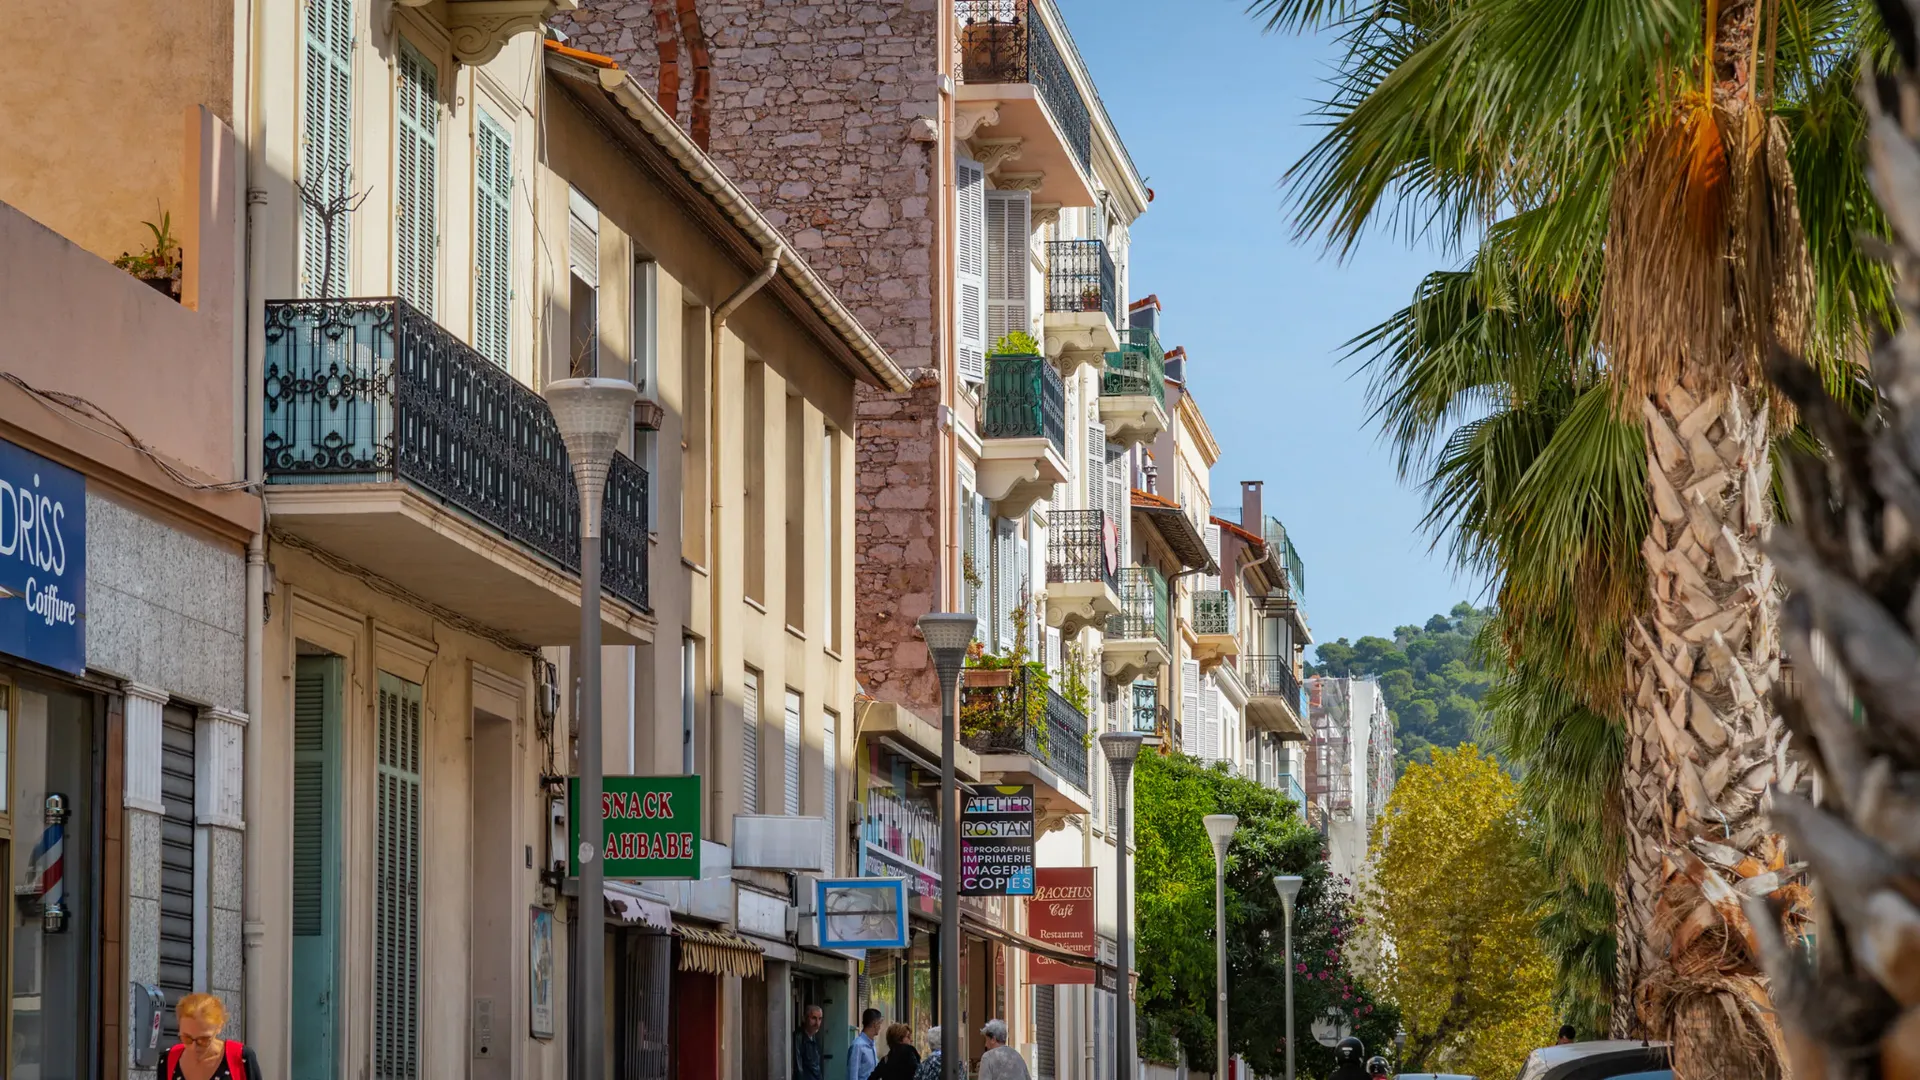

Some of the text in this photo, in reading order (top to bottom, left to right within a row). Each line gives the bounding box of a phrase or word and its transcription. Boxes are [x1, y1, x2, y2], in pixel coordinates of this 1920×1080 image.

[25, 576, 76, 626] Coiffure
[964, 796, 1032, 813] ATELIER
[962, 821, 1031, 837] ROSTAN
[602, 831, 694, 860] AHBABE
[963, 845, 1031, 853] REPROGRAPHIE
[963, 854, 1031, 863] IMPRIMERIE
[963, 865, 1031, 875] IMAGERIE
[963, 877, 1031, 890] COPIES
[1031, 886, 1093, 901] BACCHUS
[1048, 903, 1074, 918] Café
[1040, 929, 1083, 939] Restaurant
